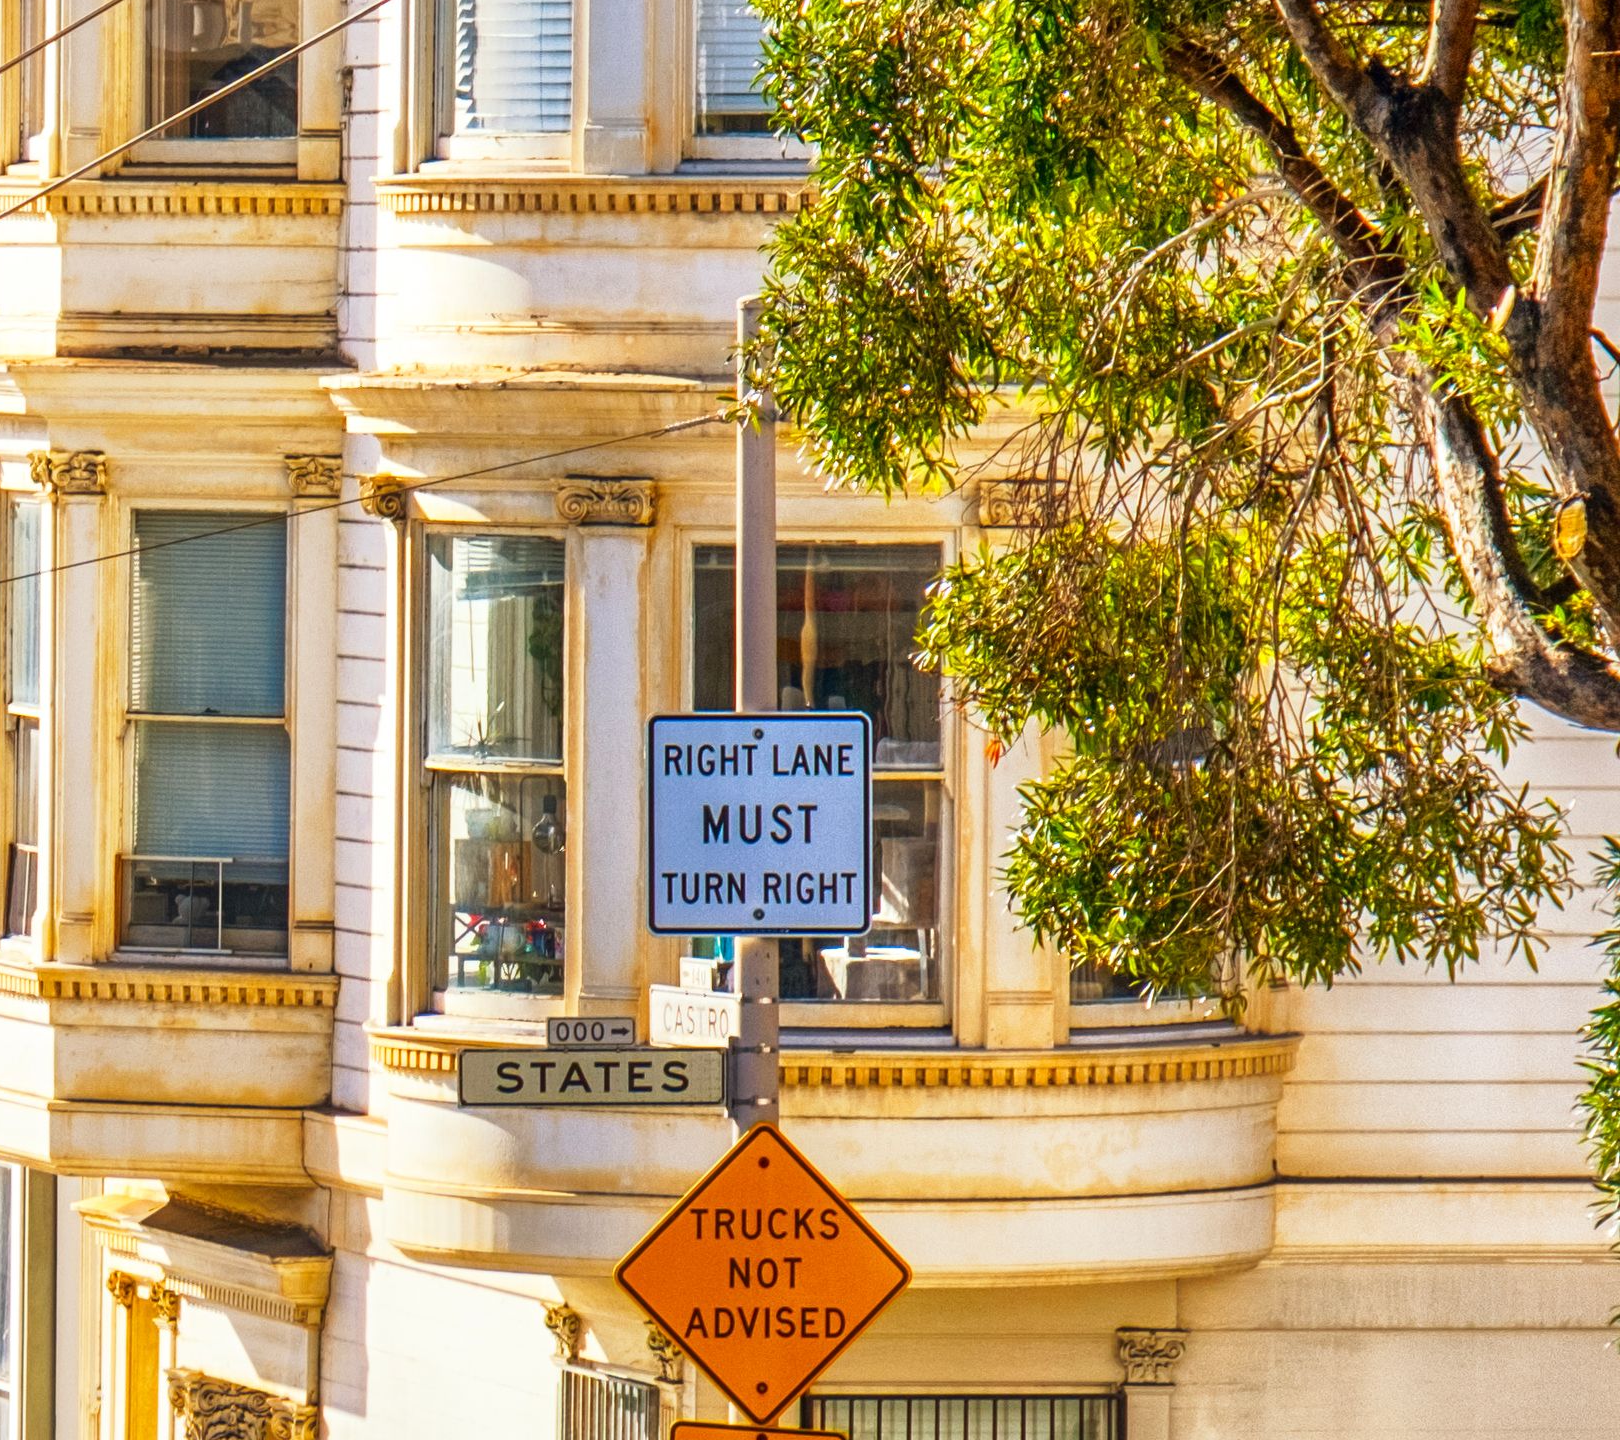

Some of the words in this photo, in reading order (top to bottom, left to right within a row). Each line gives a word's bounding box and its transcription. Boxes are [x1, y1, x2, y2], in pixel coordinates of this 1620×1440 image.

[664, 743, 758, 776] RIGHT
[772, 743, 854, 777] LANE
[703, 805, 817, 845] MUST
[662, 872, 746, 905] TURN
[762, 872, 858, 906] RIGHT
[556, 1021, 605, 1042] 000
[664, 1002, 730, 1039] CASTRO
[496, 1061, 690, 1094] STATES
[690, 1208, 840, 1241] TRUCKS
[728, 1257, 801, 1289] NOT
[685, 1306, 848, 1340] ADVISED
